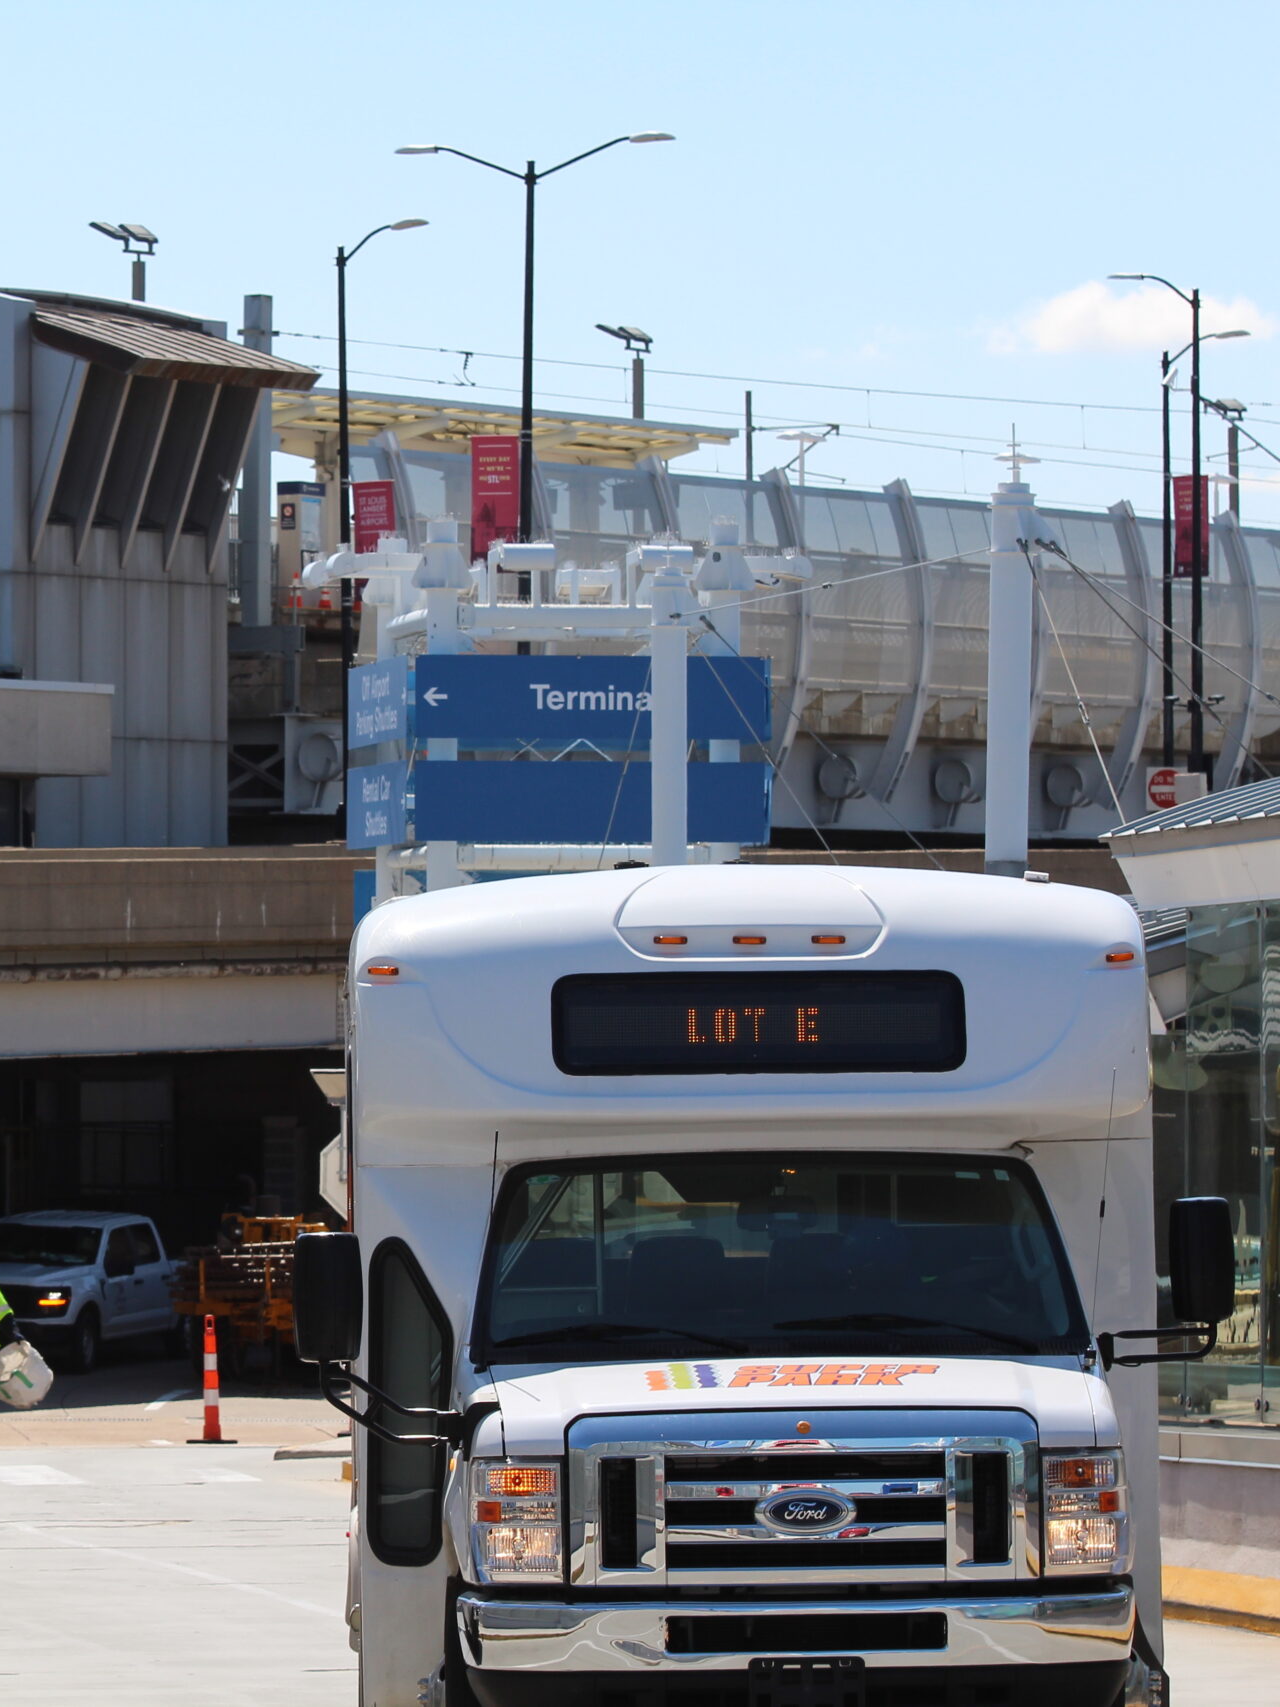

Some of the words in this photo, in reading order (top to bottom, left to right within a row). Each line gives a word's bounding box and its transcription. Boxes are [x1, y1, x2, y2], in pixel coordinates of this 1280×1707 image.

[371, 672, 389, 704] Airport
[529, 683, 652, 711] Termina
[356, 710, 373, 739] Parking
[375, 705, 397, 733] Shuttles
[363, 776, 380, 803] Rental
[381, 775, 390, 801] Car
[1155, 792, 1173, 801] ENTE
[365, 810, 387, 837] Shuttles
[688, 1008, 766, 1043] LOT
[797, 1007, 819, 1043] E
[727, 1372, 908, 1388] PARK
[735, 1364, 940, 1374] SUPER
[784, 1501, 827, 1520] Ford
